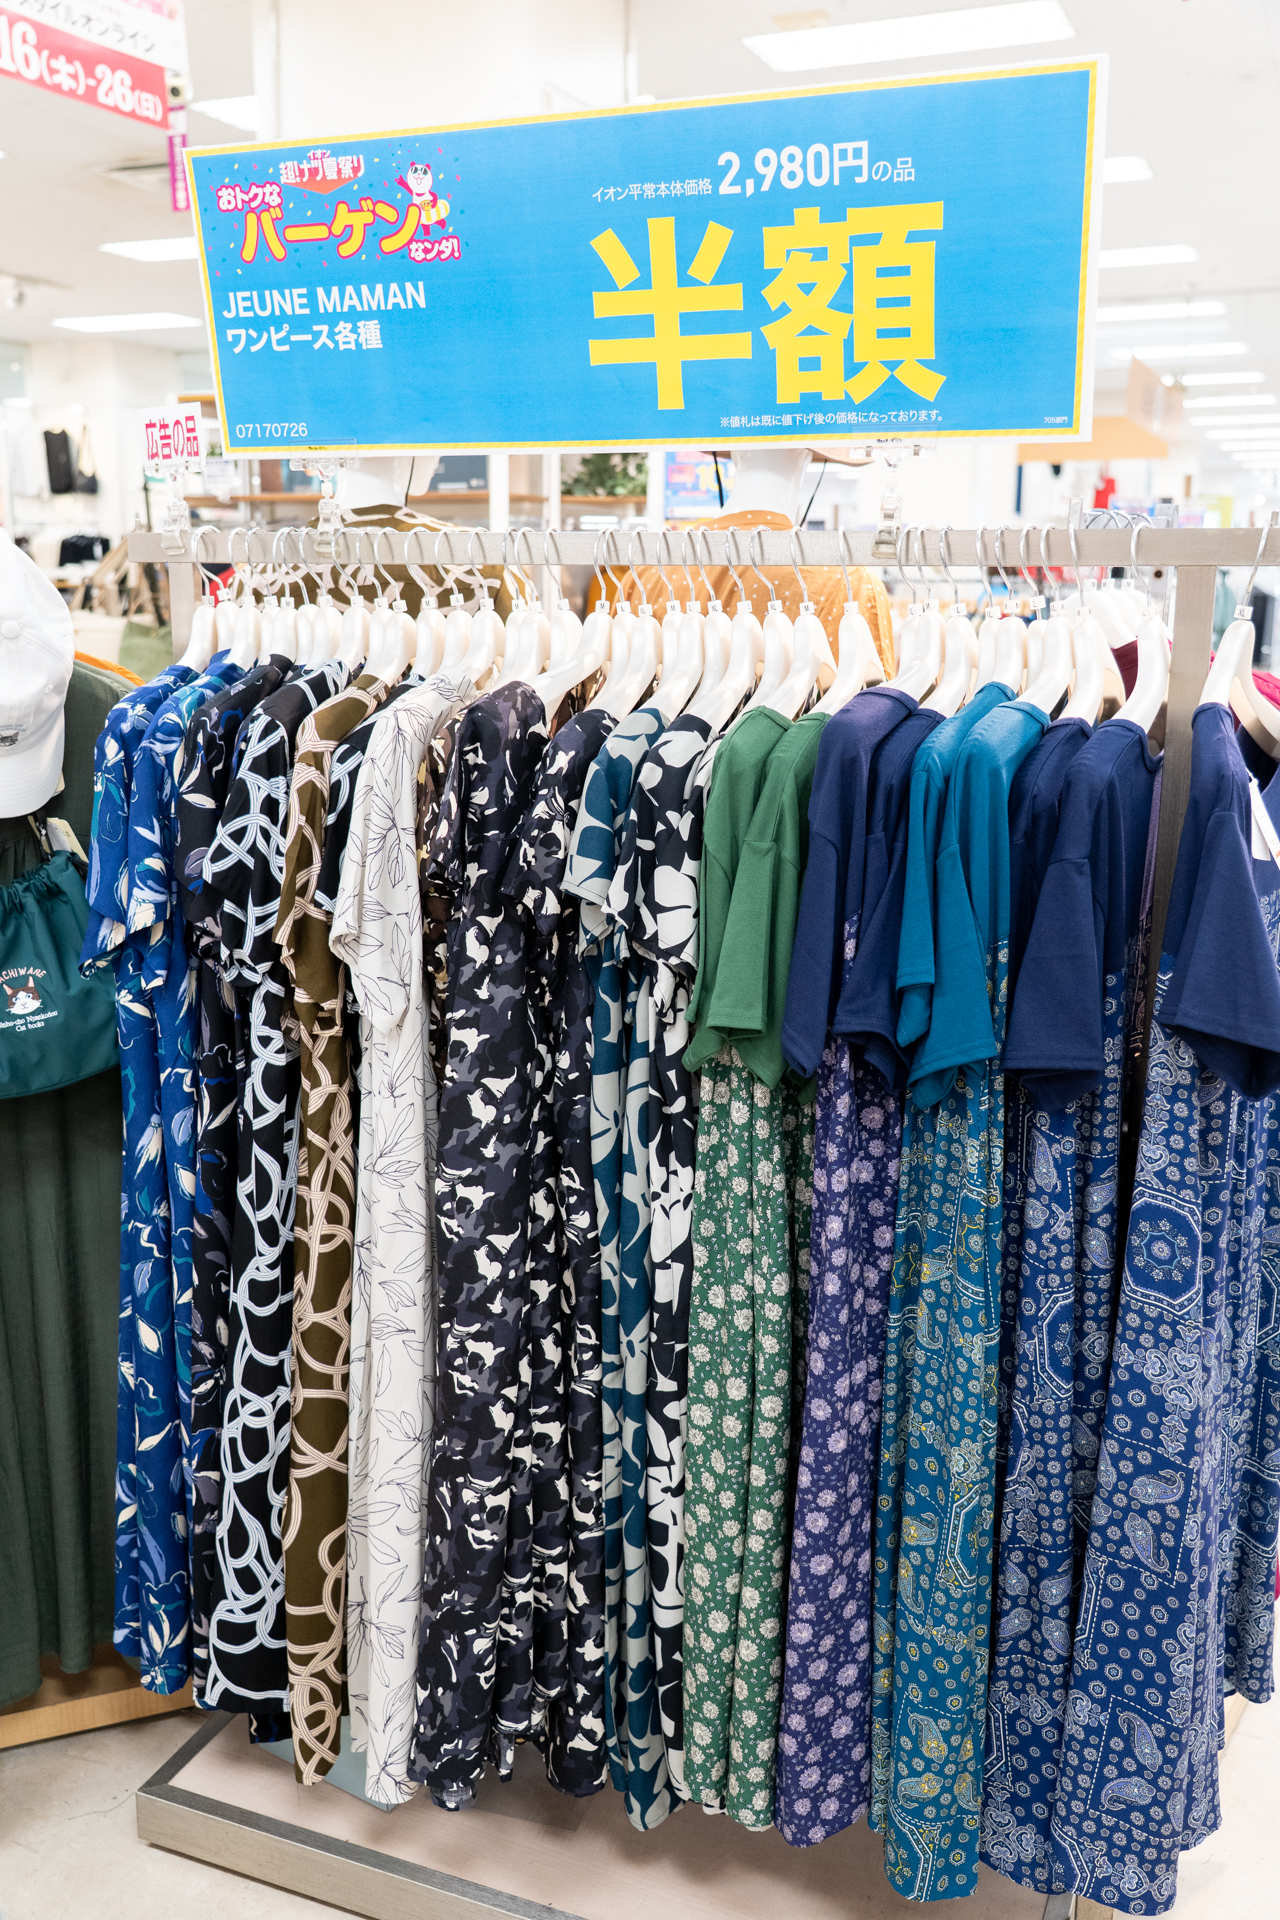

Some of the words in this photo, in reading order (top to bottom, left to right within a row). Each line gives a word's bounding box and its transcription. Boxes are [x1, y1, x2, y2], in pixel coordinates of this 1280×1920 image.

[217, 183, 282, 211] おトクな
[240, 198, 421, 263] バーゲン
[222, 288, 310, 318] JEUNE
[316, 281, 426, 313] MAMAN
[588, 201, 947, 410] 半額
[226, 319, 383, 354] ワンピース各種
[145, 415, 199, 461] 広告の品
[235, 422, 308, 438] 07170726
